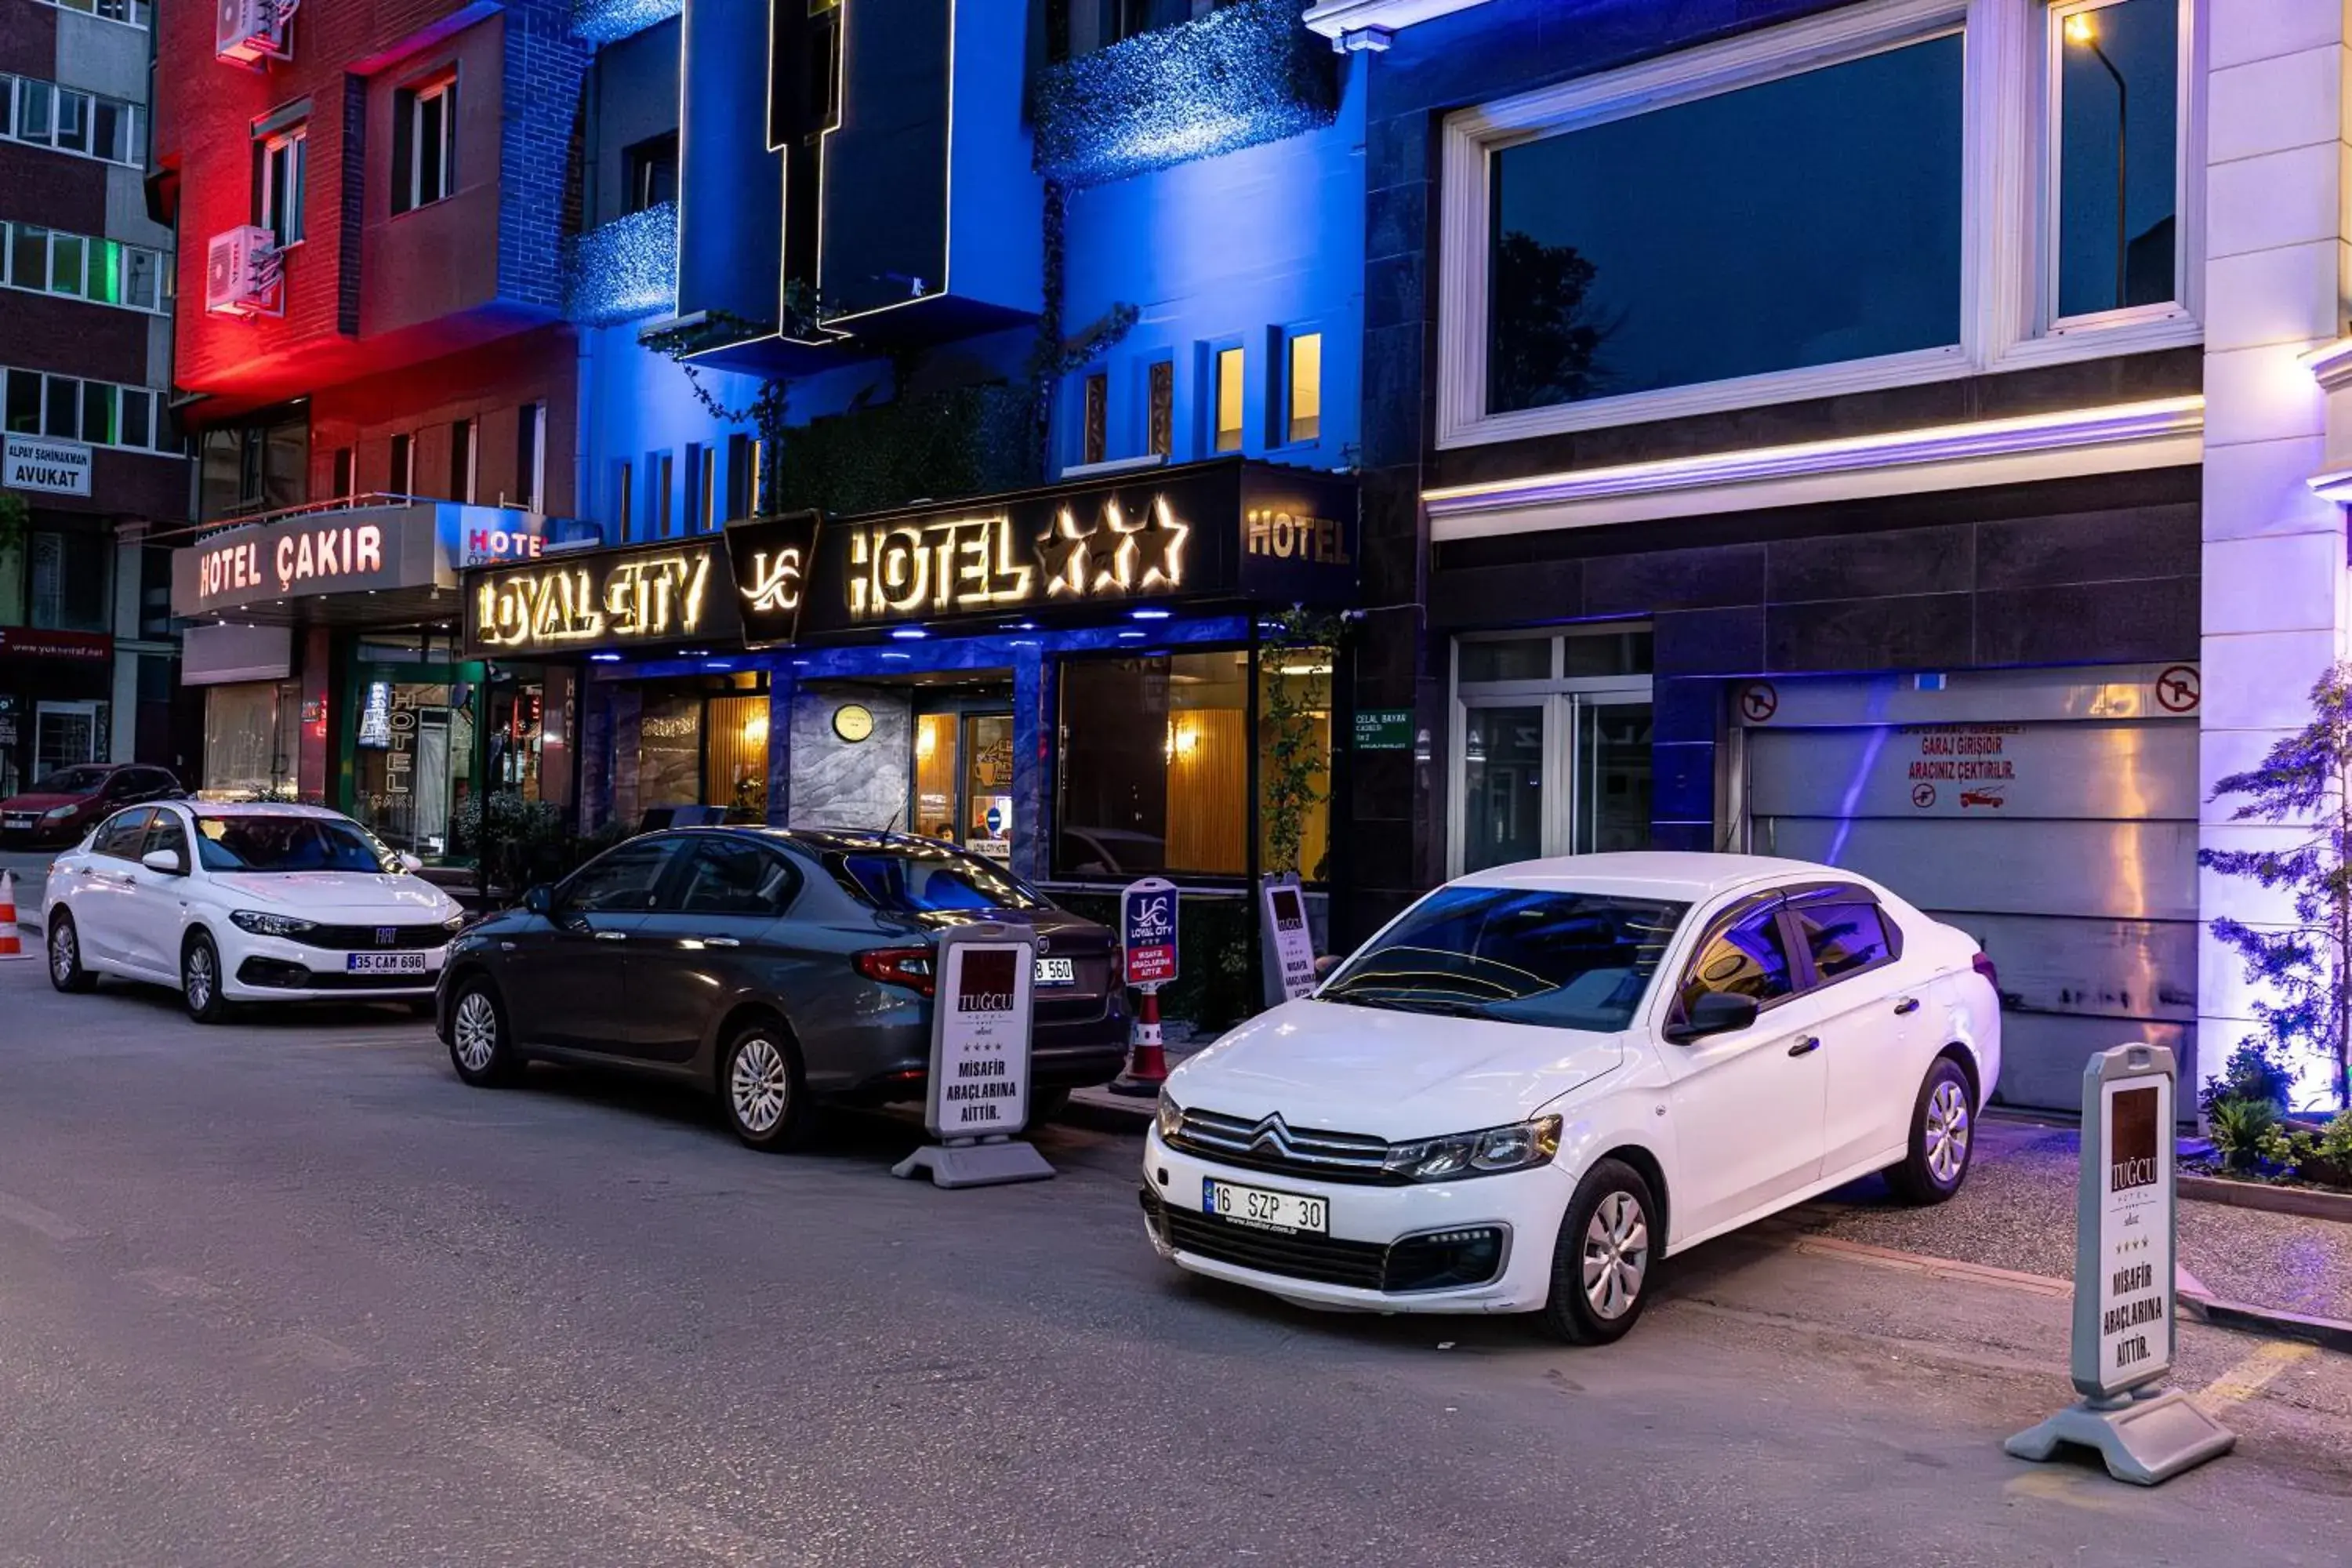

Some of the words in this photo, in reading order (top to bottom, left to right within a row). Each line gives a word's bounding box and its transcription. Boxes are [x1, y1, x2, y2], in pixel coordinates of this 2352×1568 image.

[16, 465, 79, 488] AVUKAT
[469, 528, 549, 557] HOTE
[1248, 510, 1351, 564] HOTEL
[201, 542, 261, 597] HOTEL
[277, 524, 381, 592] ÇAKIR
[477, 568, 605, 644] LOYAL
[604, 554, 710, 633] CITY
[849, 516, 1033, 613] HOTEL
[387, 691, 418, 793] HOTEL
[1922, 737, 1954, 755] GARAJ
[376, 927, 397, 944] FIAT
[1131, 927, 1155, 938] LOYAL
[1156, 925, 1174, 936] CITY
[357, 956, 371, 968] 35
[401, 956, 422, 968] 696
[1048, 960, 1070, 978] 560
[960, 992, 1014, 1011] TUĞCU
[958, 1058, 1006, 1078] MİSAFİR
[946, 1082, 1017, 1102] ARAÇLARINA
[960, 1102, 1001, 1122] AİTTİR.
[2112, 1156, 2158, 1190] TUĞCU
[1216, 1186, 1231, 1212] 16
[1248, 1192, 1280, 1221] SZP
[1298, 1201, 1321, 1229] 30
[2113, 1260, 2153, 1297] MİSAFİR
[2103, 1296, 2163, 1336] ARAÇLARINA
[2116, 1336, 2151, 1368] AİTTİR.
